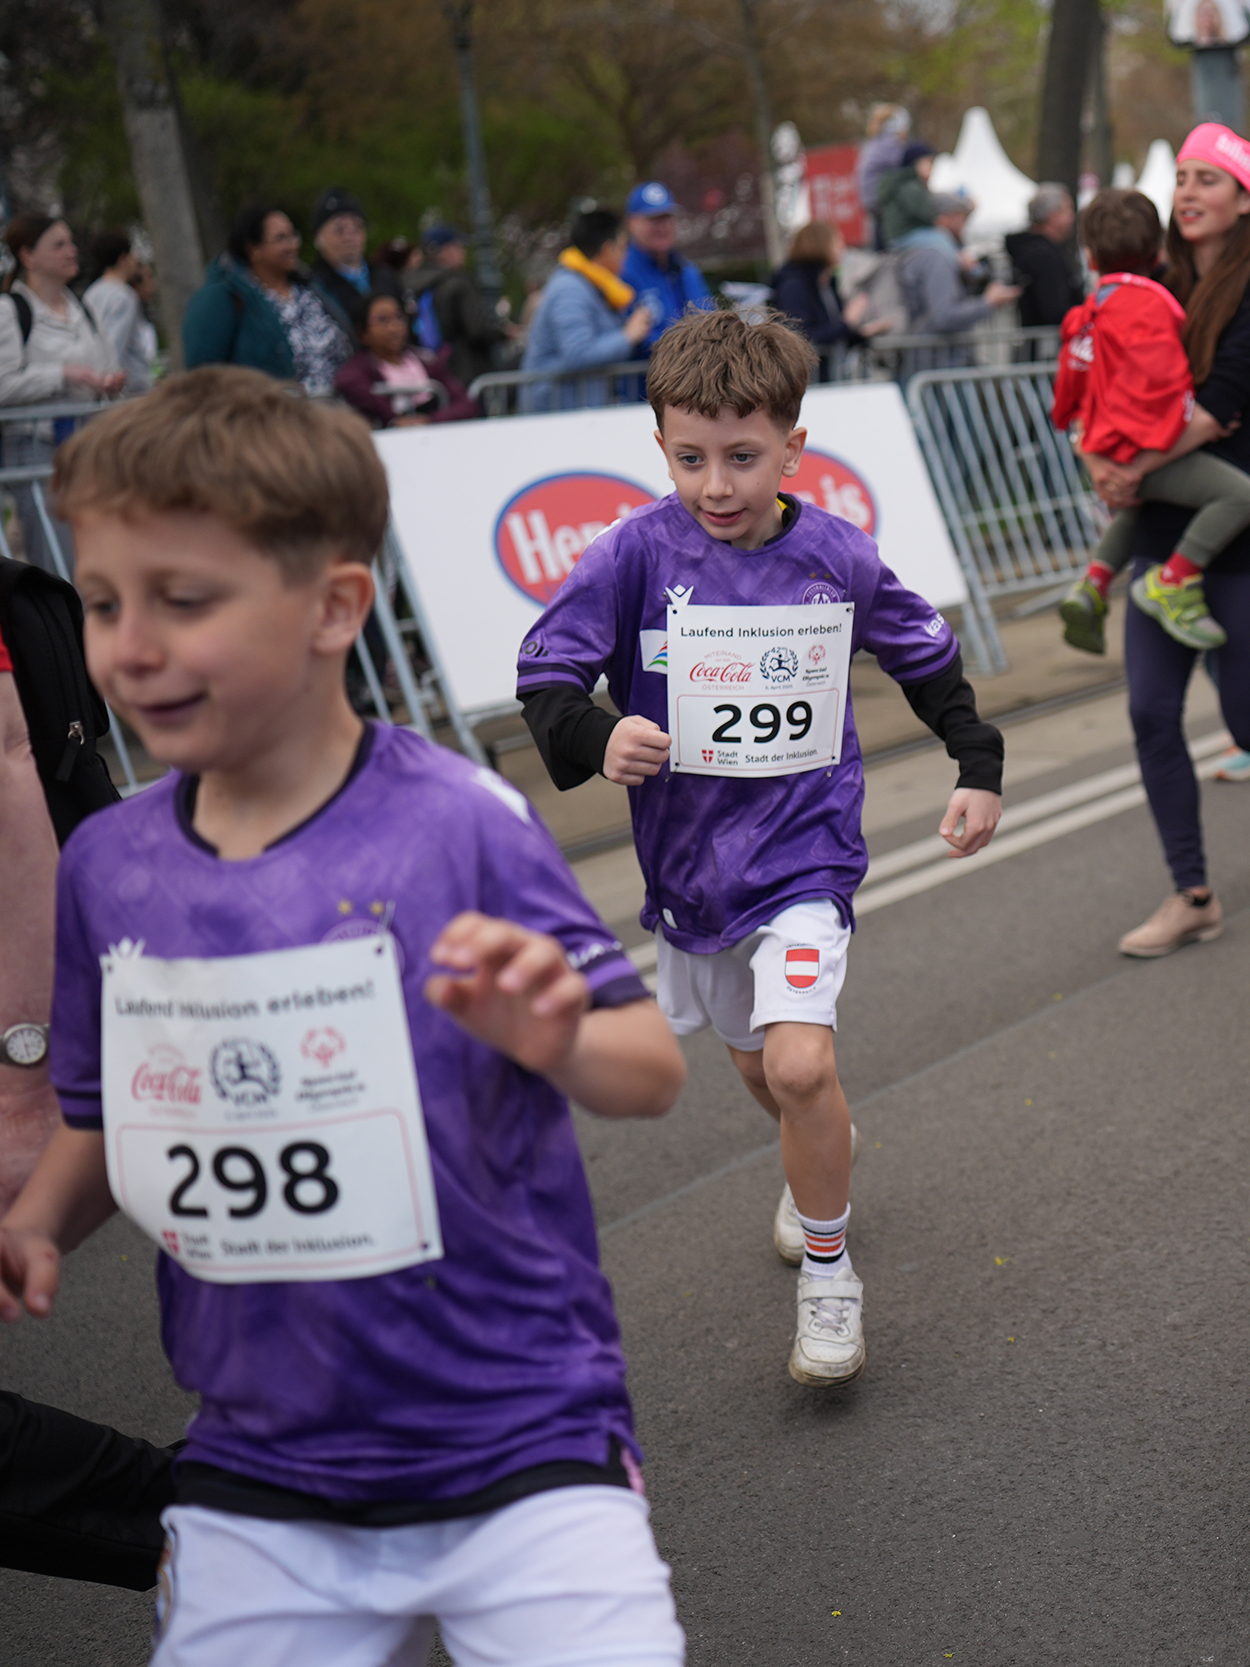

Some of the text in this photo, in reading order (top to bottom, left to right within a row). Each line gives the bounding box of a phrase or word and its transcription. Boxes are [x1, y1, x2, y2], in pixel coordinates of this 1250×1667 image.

[681, 623, 842, 638] Laufend Inklusion erleben!
[689, 662, 756, 683] Coca-Cola
[771, 675, 790, 683] VCM
[712, 700, 813, 744] 299
[718, 749, 818, 763] Stadt Stadt der Inklusion.
[115, 996, 173, 1017] Laufend
[268, 980, 376, 1014] erleben!
[131, 1061, 202, 1104] Coca-Cola
[167, 1140, 340, 1220] 298
[221, 1240, 259, 1256] Stadt
[266, 1240, 288, 1254] der
